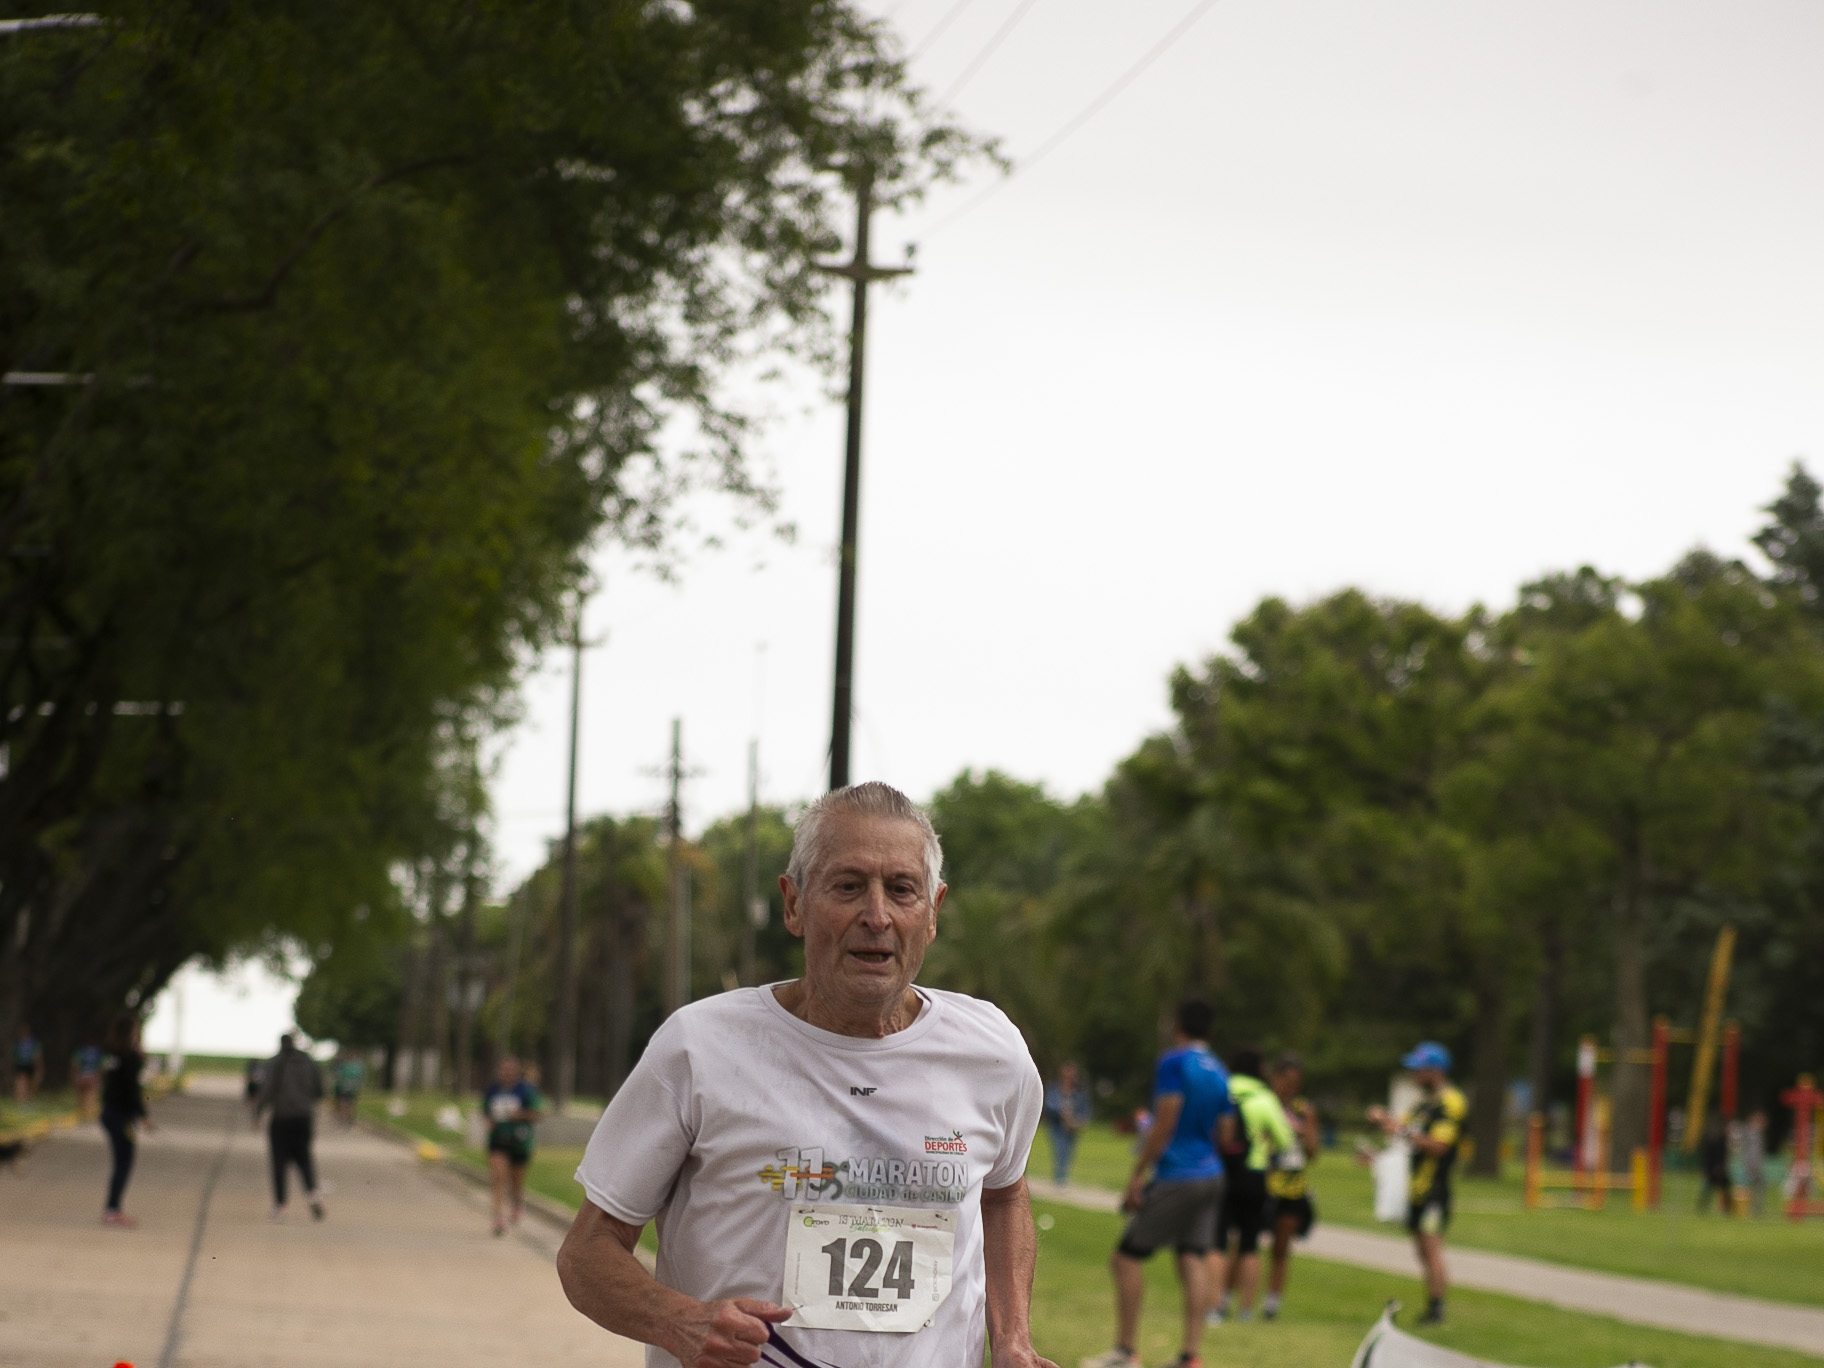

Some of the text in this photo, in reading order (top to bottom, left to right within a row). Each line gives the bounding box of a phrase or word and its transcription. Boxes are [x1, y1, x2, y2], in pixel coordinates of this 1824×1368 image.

[924, 1141, 967, 1152] DEPORTES
[847, 1157, 968, 1188] MARATON
[846, 1185, 898, 1201] CIUDAD
[902, 1188, 917, 1201] de
[821, 1237, 915, 1299] 124
[835, 1300, 898, 1312] ANTONIO TORRESAN
